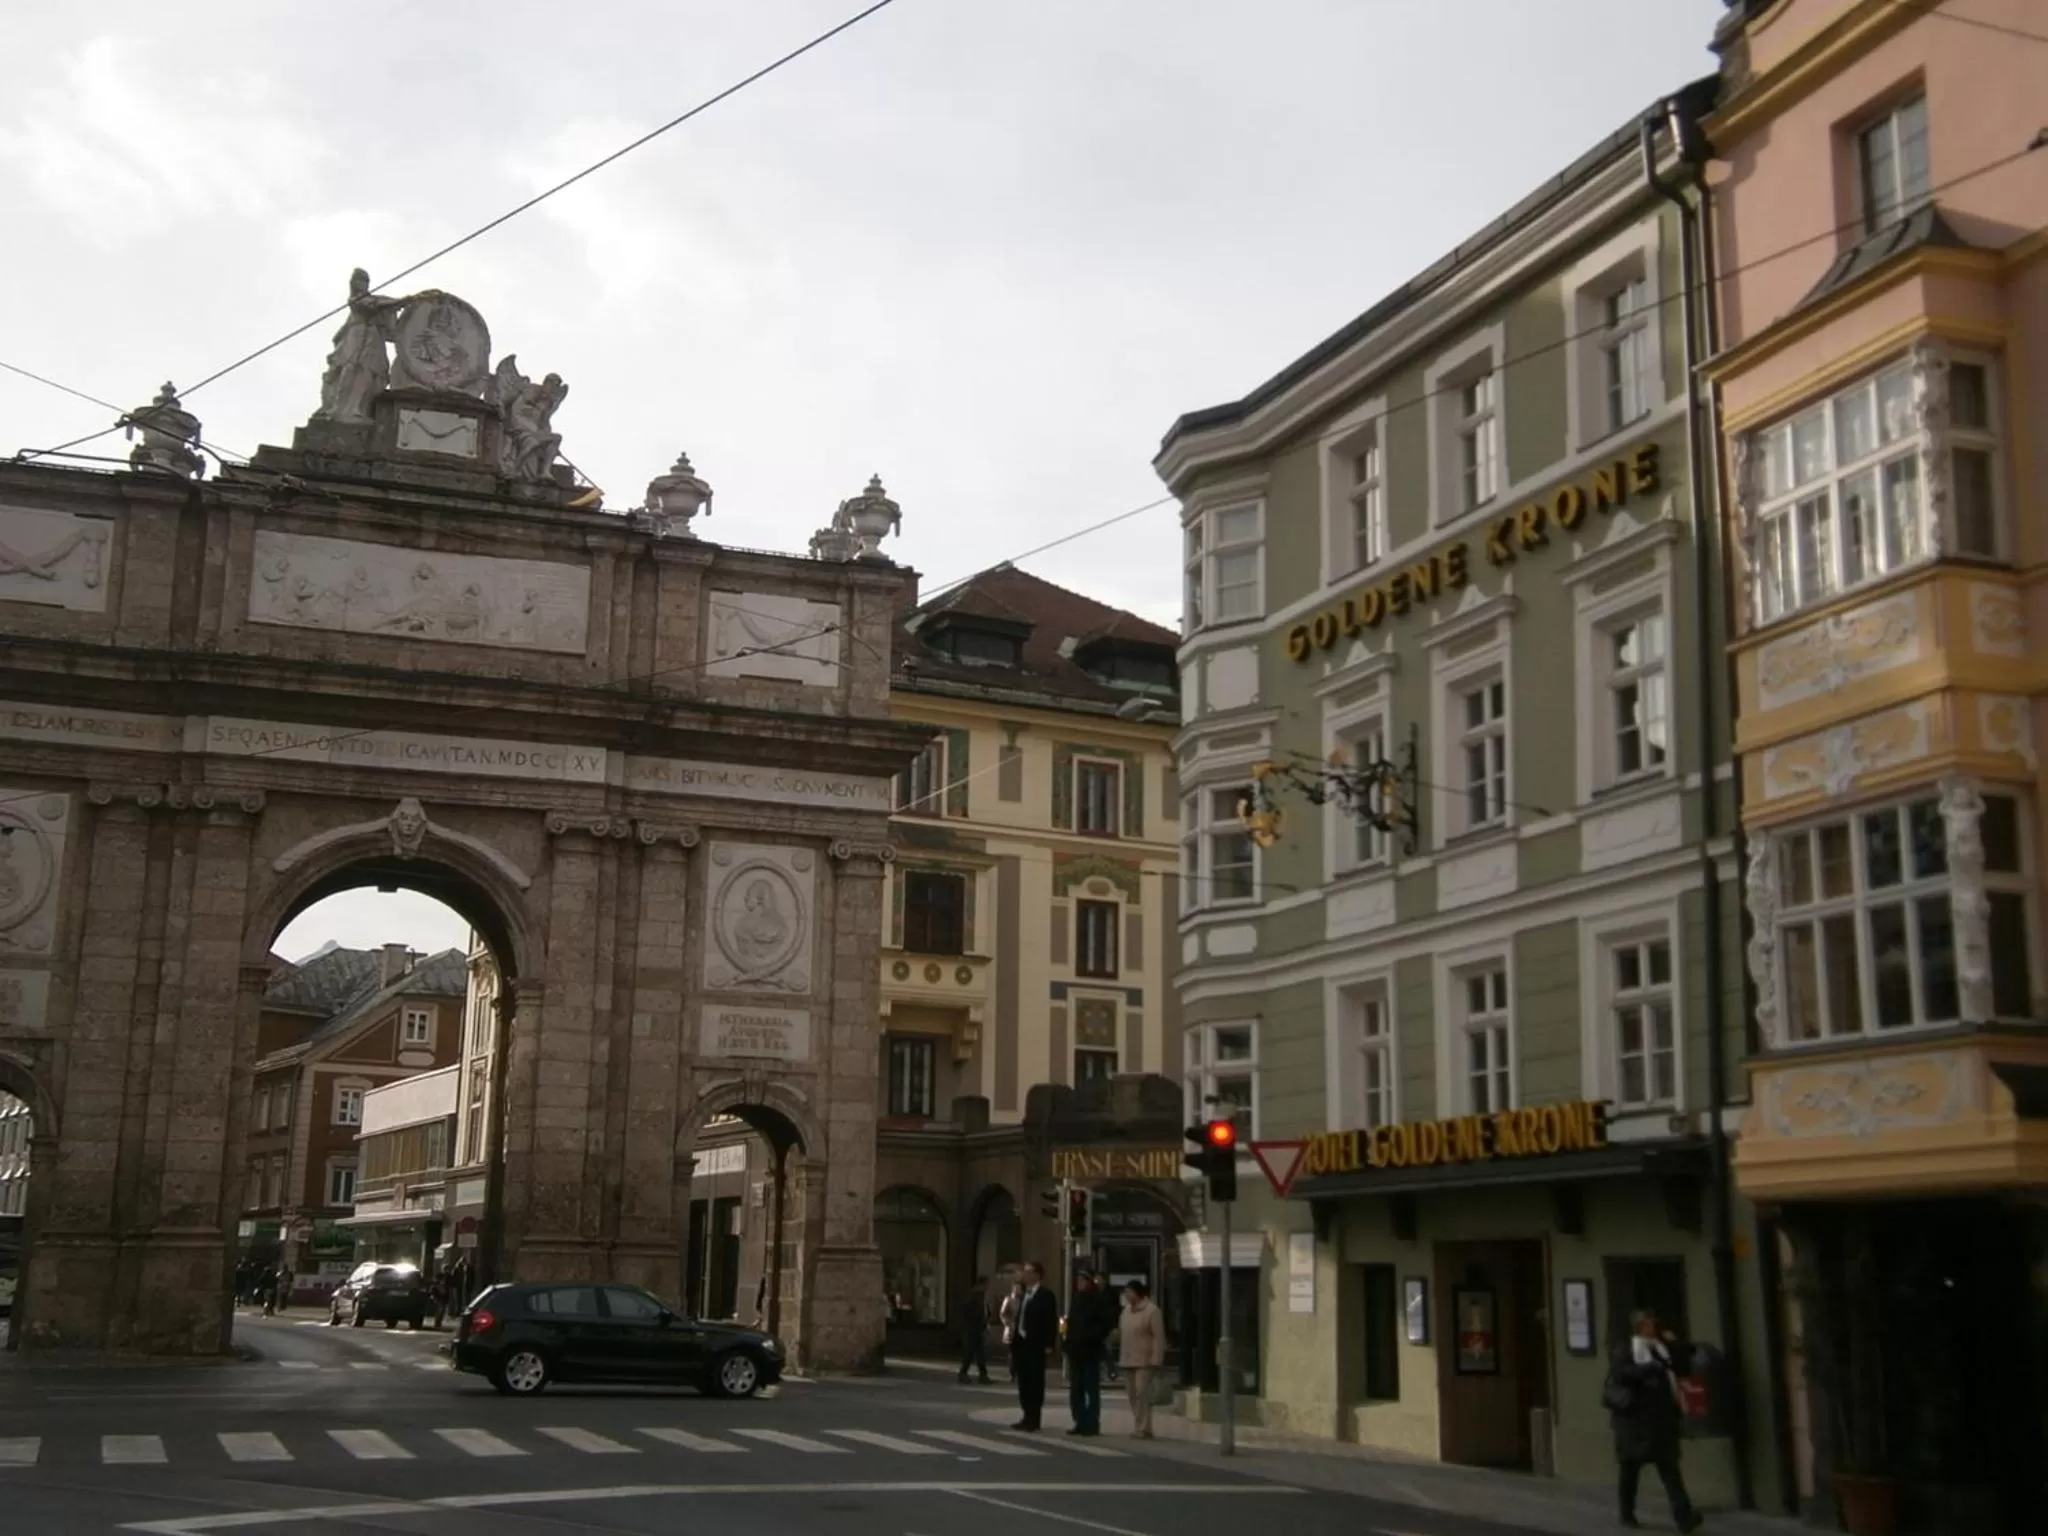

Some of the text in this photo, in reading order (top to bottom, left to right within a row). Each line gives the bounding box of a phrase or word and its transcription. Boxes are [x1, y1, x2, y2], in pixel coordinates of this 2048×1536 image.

[1285, 442, 1660, 663] GOLDENE KRONE
[1368, 1115, 1493, 1168] GOLDENE
[1498, 1100, 1606, 1157] KRONE
